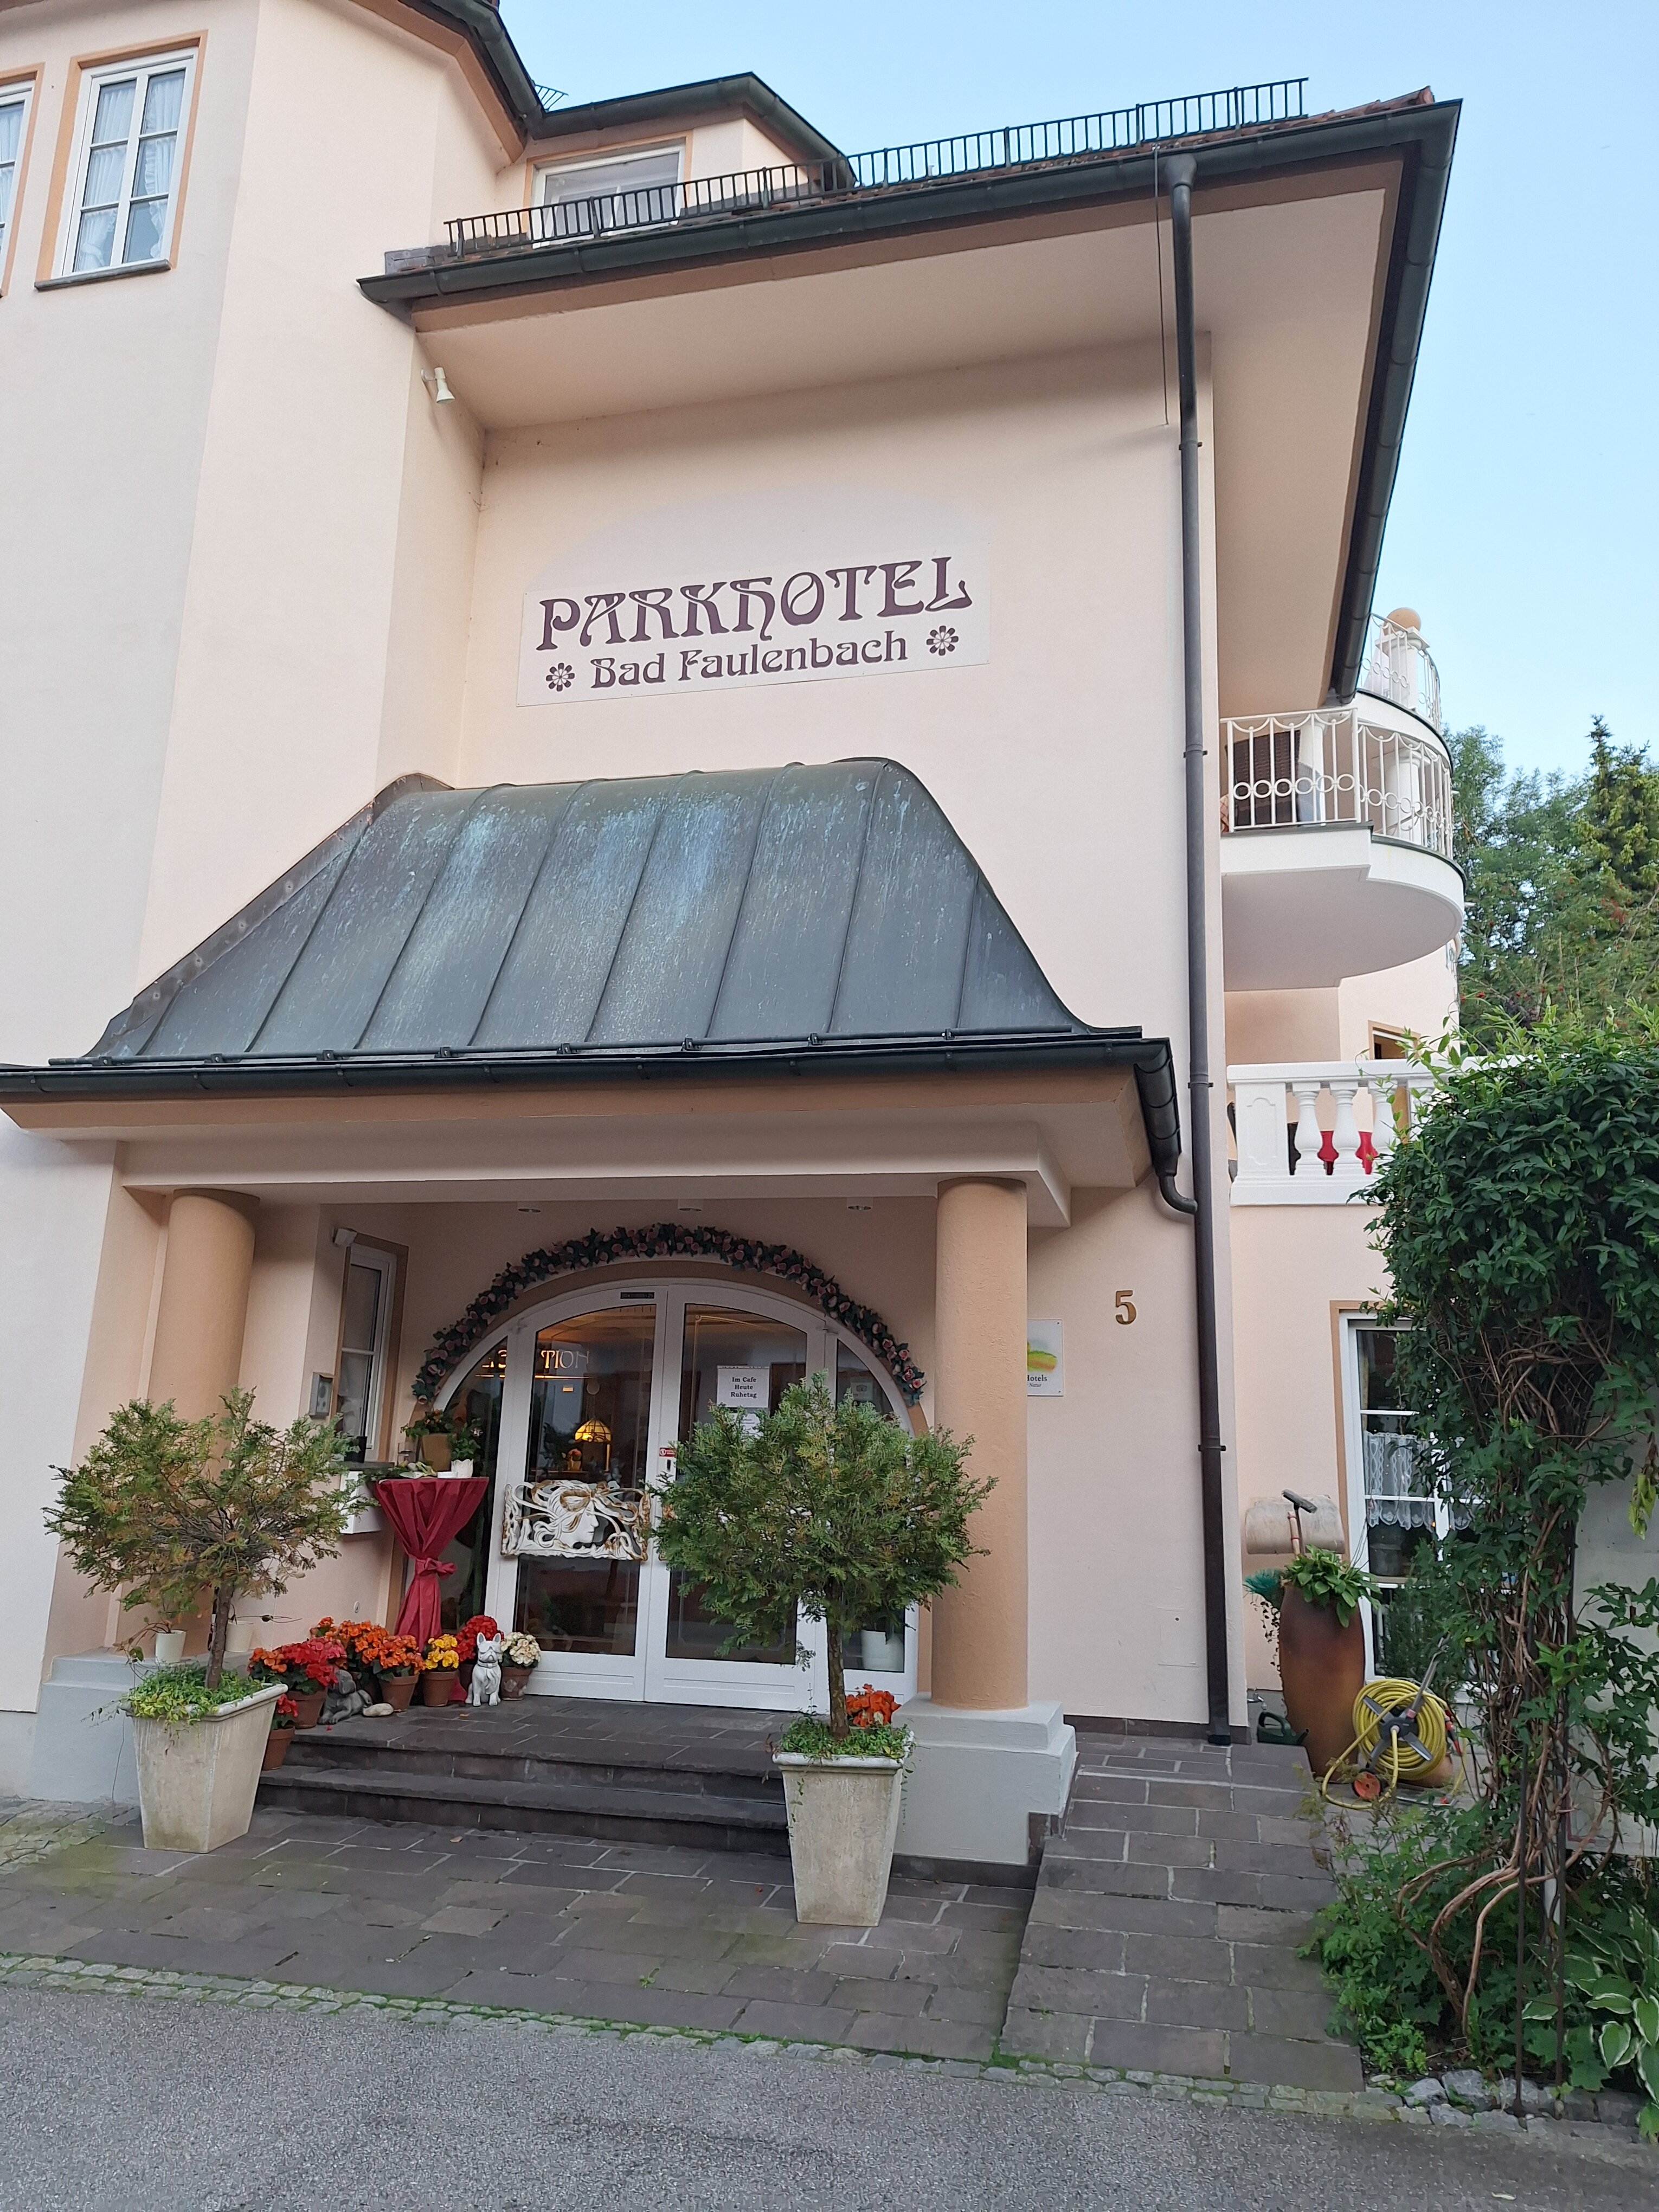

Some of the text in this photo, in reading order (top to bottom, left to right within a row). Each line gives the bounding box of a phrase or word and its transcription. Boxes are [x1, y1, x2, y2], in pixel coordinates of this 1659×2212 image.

[536, 557, 973, 650] PARKHOTEL
[590, 631, 908, 689] Bad Faulenbach
[1115, 1290, 1137, 1325] 5
